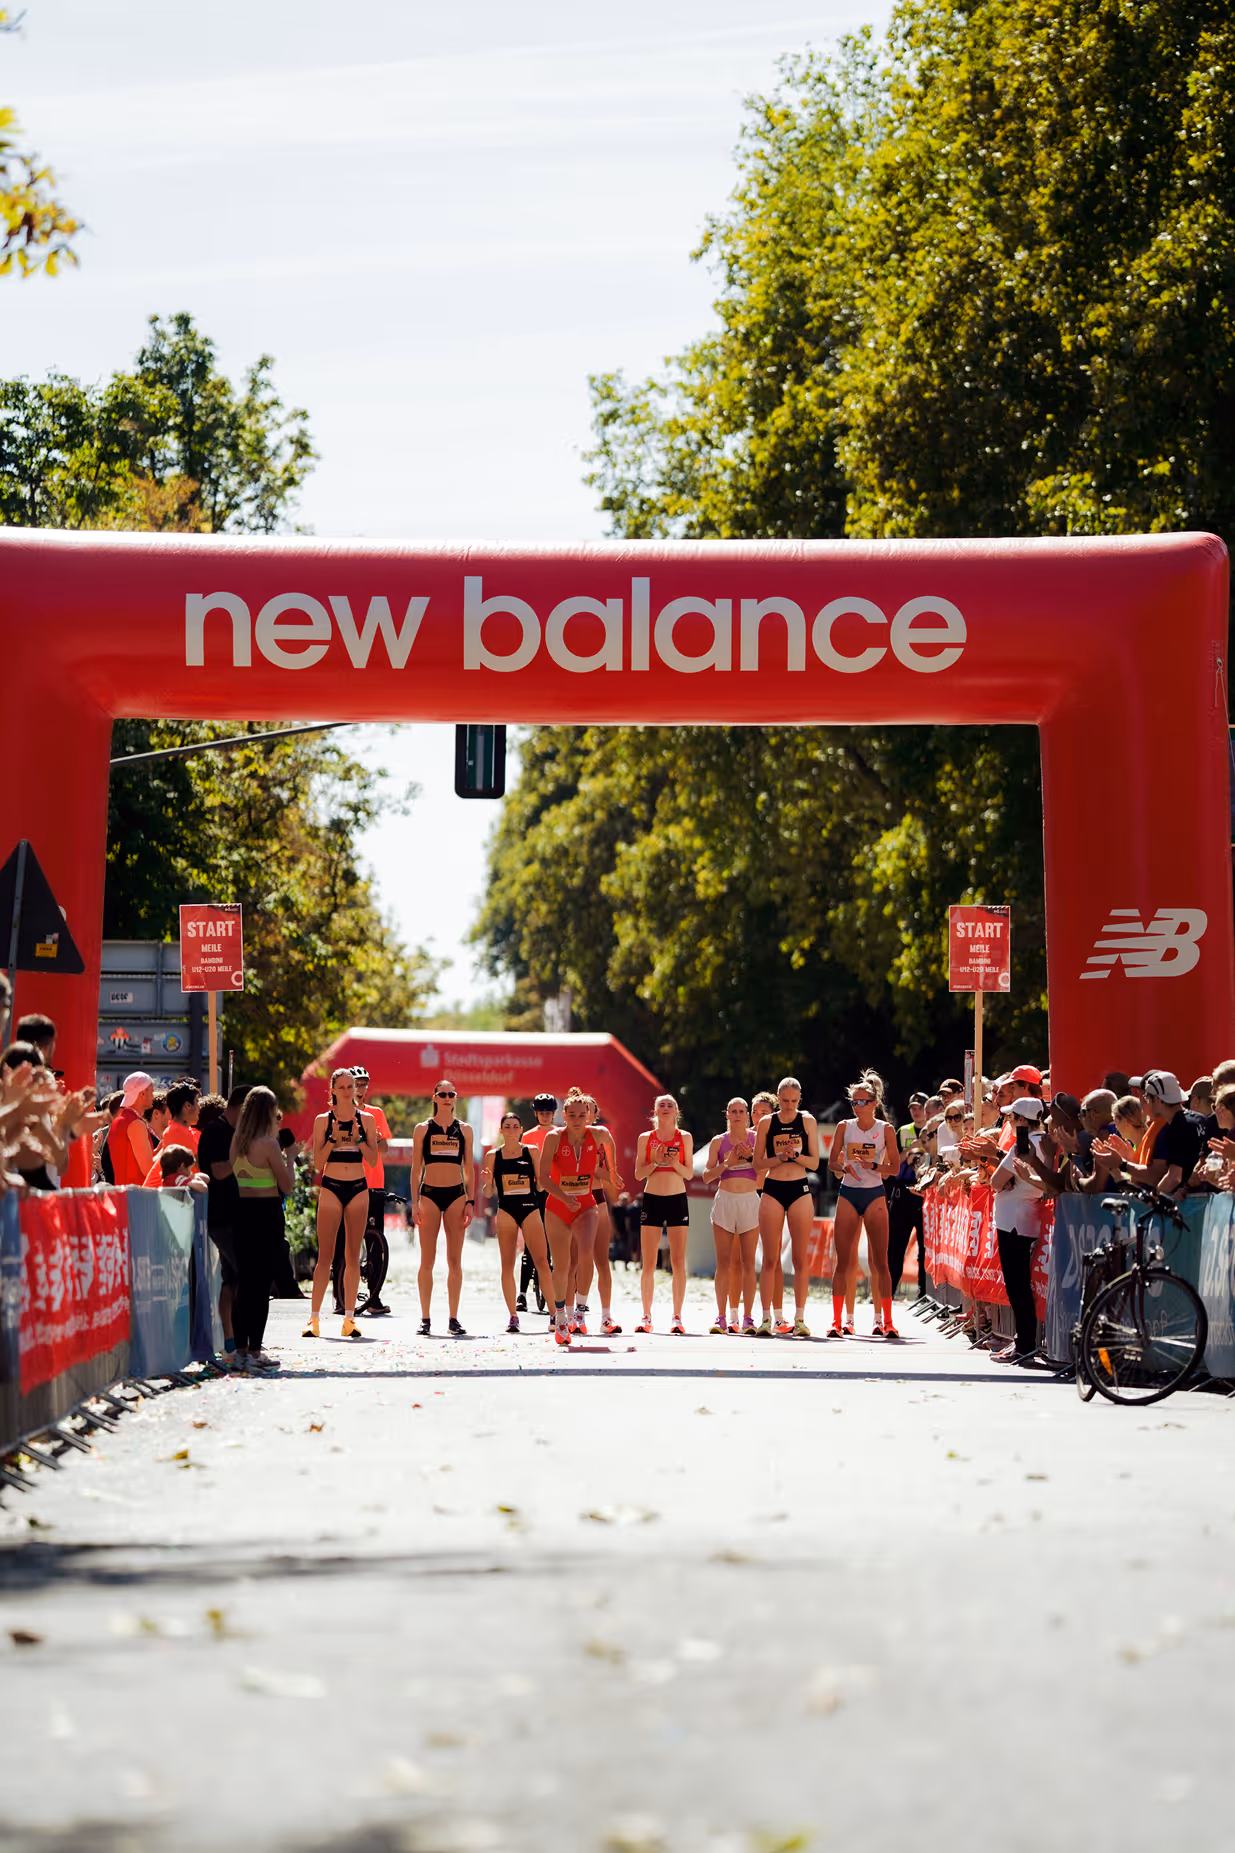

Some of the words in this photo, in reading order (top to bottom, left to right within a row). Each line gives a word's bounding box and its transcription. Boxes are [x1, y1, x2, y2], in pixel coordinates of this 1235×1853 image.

[185, 591, 430, 670] new
[463, 576, 967, 673] balance
[187, 921, 235, 937] START
[956, 922, 1003, 938] START
[201, 944, 222, 953] MEILE
[969, 944, 990, 953] MEILE
[432, 1139, 459, 1148] Kimberley
